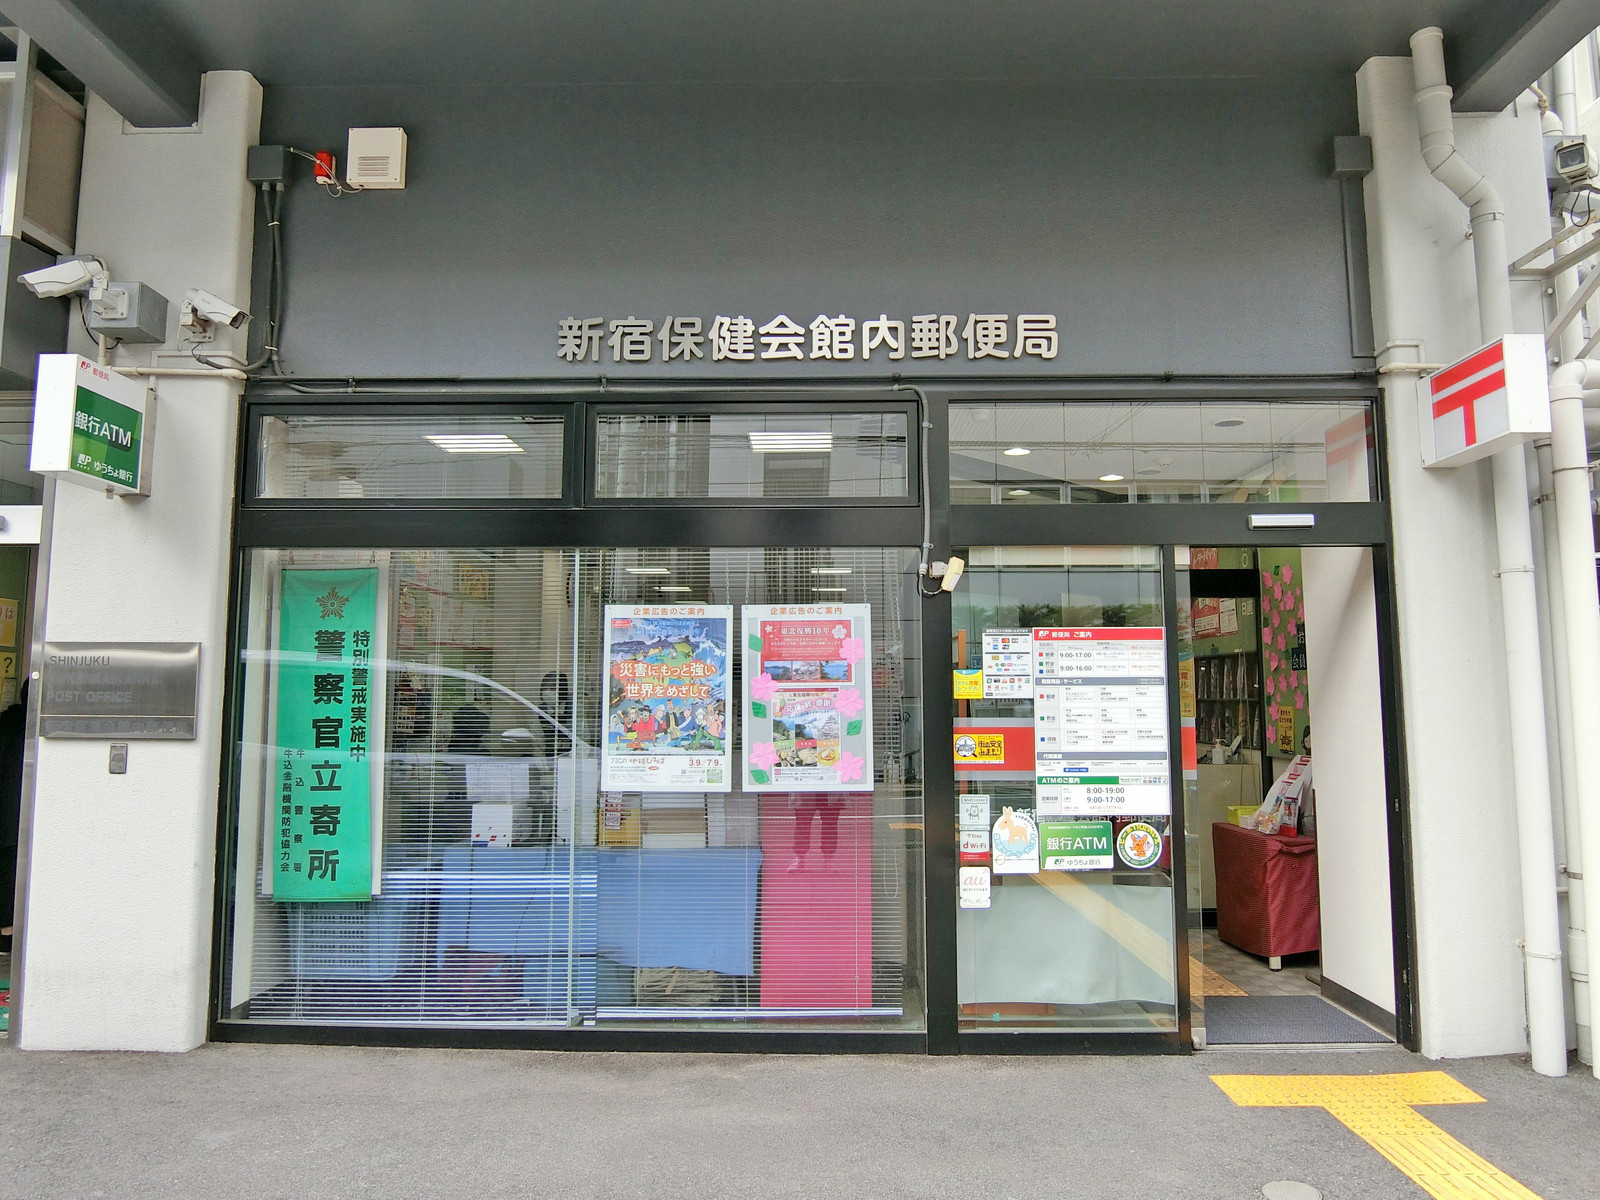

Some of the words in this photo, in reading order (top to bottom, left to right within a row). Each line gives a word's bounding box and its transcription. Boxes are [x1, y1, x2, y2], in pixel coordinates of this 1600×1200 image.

[557, 313, 1059, 362] 新宿保健会館内郵便局
[92, 367, 111, 382] 郵便局
[75, 410, 132, 448] 銀行ATM
[94, 461, 133, 483] ゆうちょ銀行
[633, 607, 705, 616] 企業広告のご案内
[770, 606, 843, 615] 企業広告のご案内
[780, 627, 830, 635] 東北復興10年
[49, 655, 111, 667] SHINJUKU
[619, 662, 717, 678] 災害にもっと強い
[47, 691, 80, 703] POST
[86, 691, 134, 703] OFFICE
[350, 629, 371, 763] 特別警戒実施中
[626, 683, 710, 698] 世界をめざして
[307, 629, 346, 882] 警察官立寄所
[280, 748, 293, 873] 牛込金融機関防犯協力会
[293, 748, 305, 873] 牛込警察署
[1046, 837, 1107, 850] 銀行ATM
[963, 875, 987, 886] au
